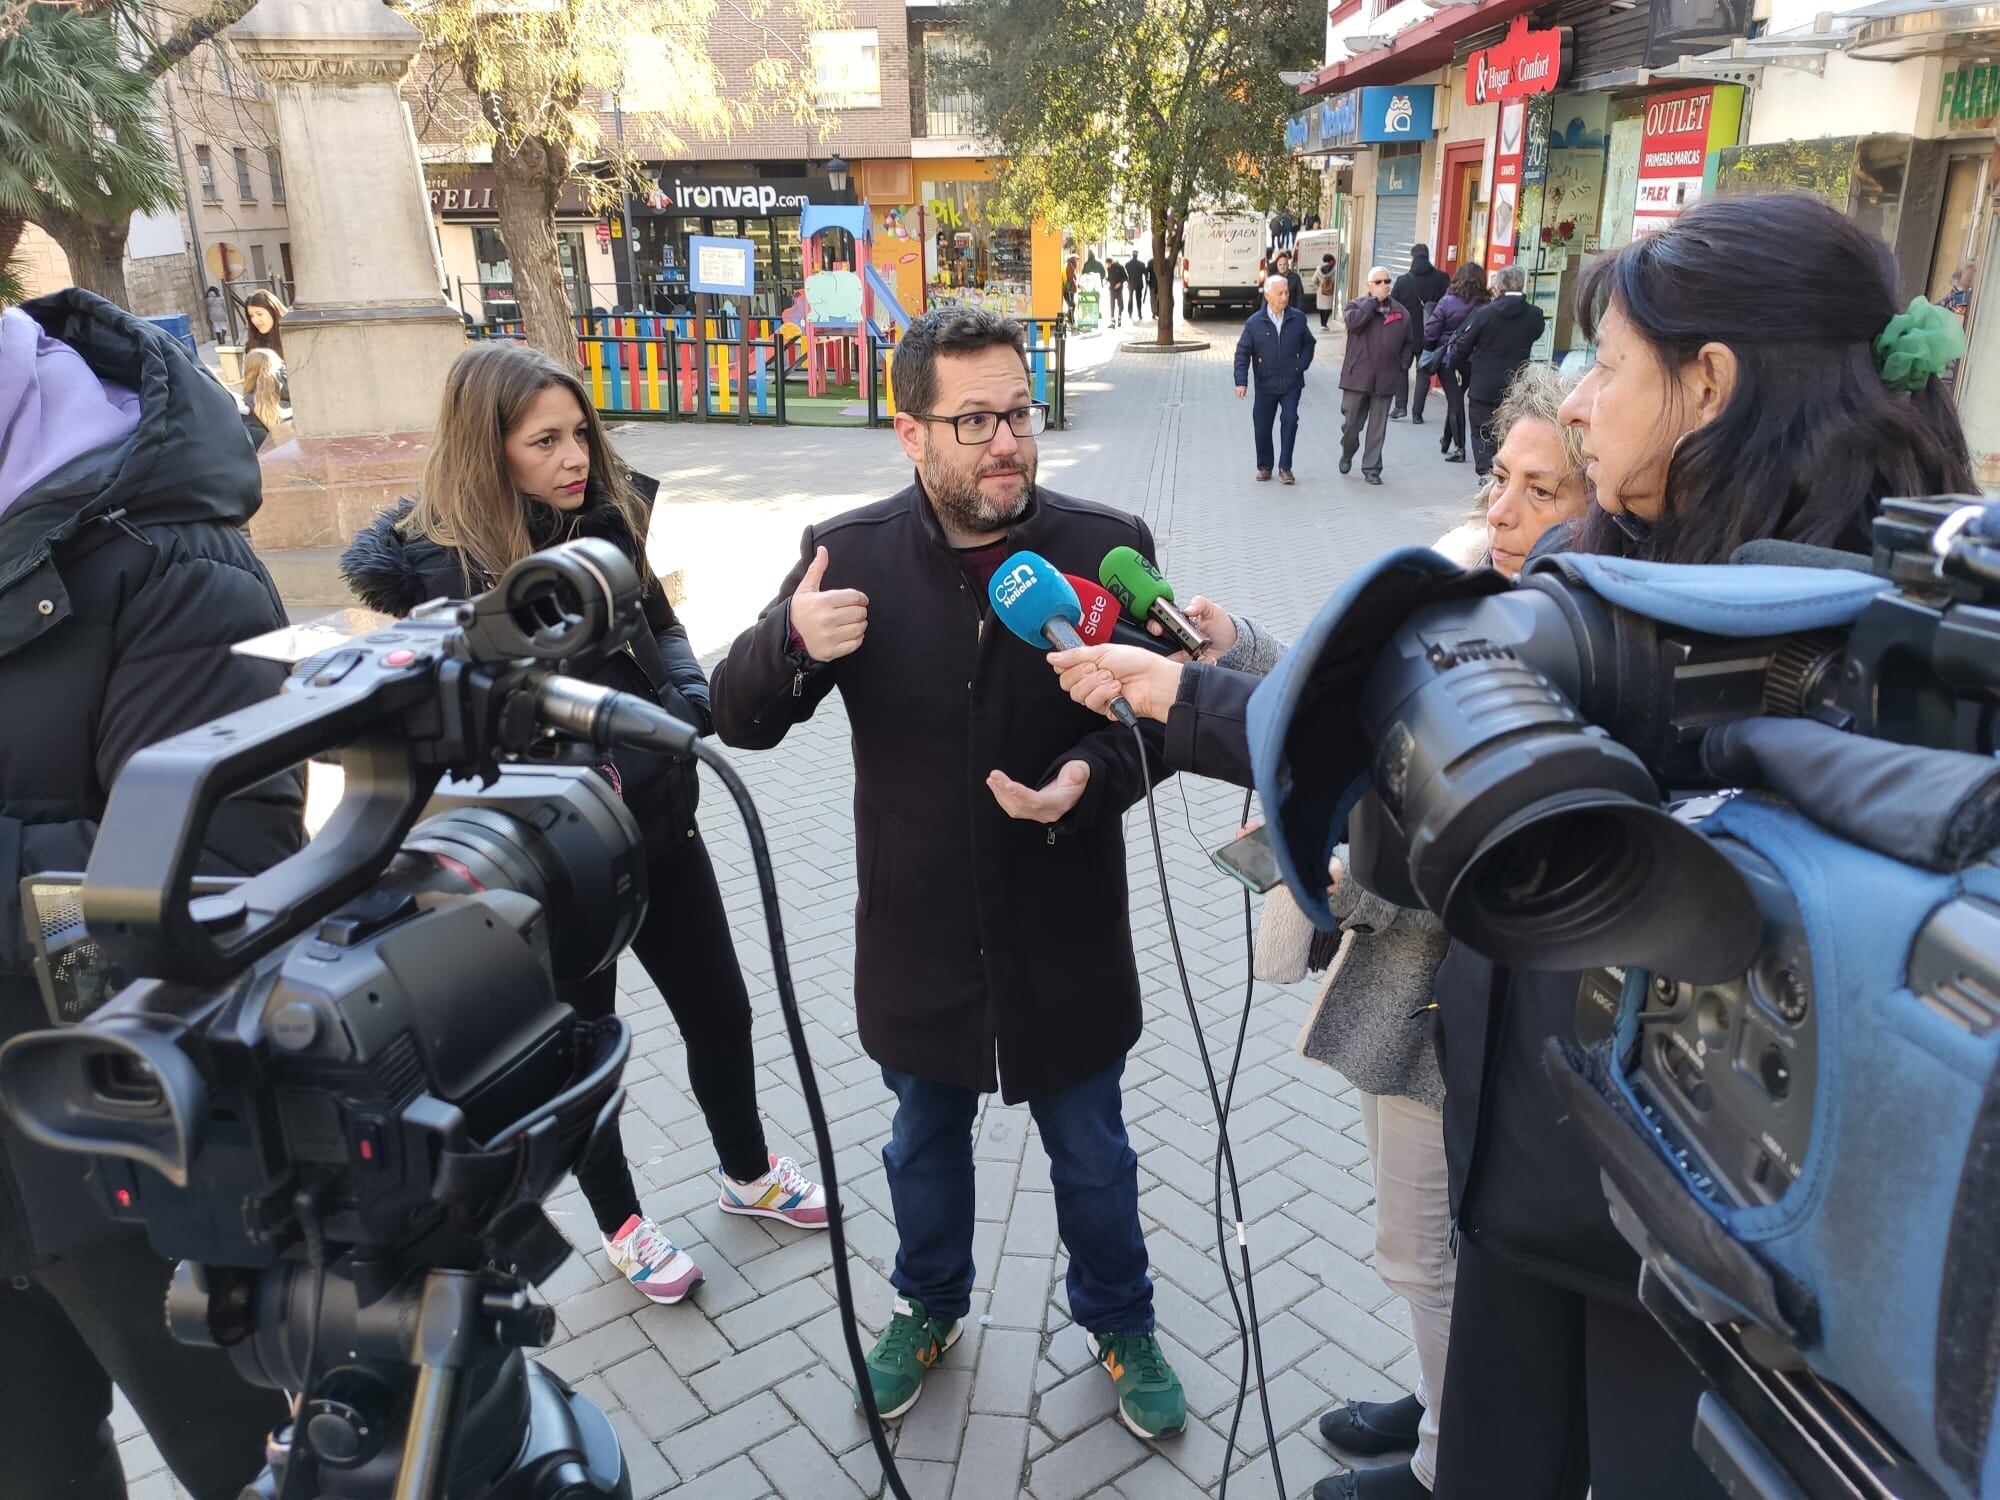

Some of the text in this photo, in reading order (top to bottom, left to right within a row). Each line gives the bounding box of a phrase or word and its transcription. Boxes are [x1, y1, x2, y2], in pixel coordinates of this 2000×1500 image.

[1488, 66, 1510, 94] Hogar
[1518, 52, 1549, 82] Confort
[1646, 94, 1711, 137] OUTLET
[1645, 152, 1675, 168] PRIMERAS
[1674, 149, 1701, 166] MARCAS
[1646, 186, 1671, 202] FLEX
